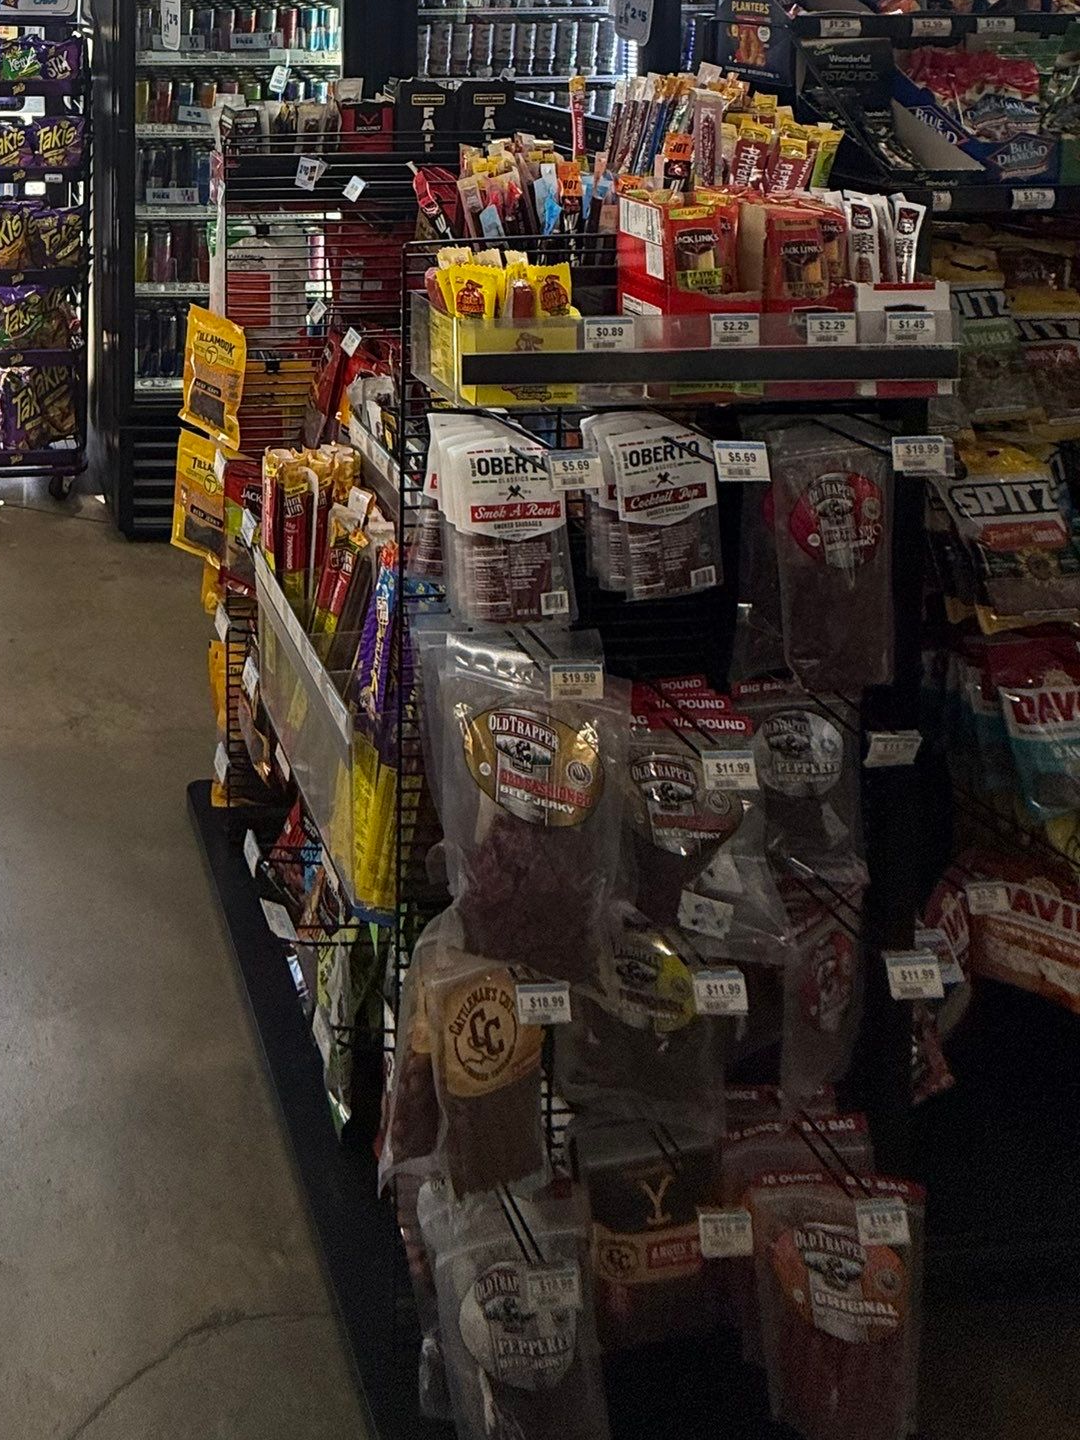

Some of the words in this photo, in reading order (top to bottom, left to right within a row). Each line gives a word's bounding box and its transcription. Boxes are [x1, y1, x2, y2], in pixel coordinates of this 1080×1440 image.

[731, 0, 770, 15] PLANTERS
[828, 54, 871, 63] Wonderful
[821, 71, 879, 82] PISTACHIOS
[37, 123, 76, 155] Takis
[1010, 140, 1036, 152] BLUE
[997, 145, 1049, 166] DIAMOND
[563, 180, 579, 190] HOT
[596, 327, 624, 336] $0.89
[723, 321, 749, 330] $2.29
[818, 321, 846, 330] $2.29
[899, 320, 925, 330] $1.49
[196, 329, 236, 358] TILLAMOOK
[13, 386, 40, 429] Tak
[629, 441, 699, 467] OBERTO
[729, 451, 757, 463] $5.69
[191, 456, 215, 473] TILLA
[477, 454, 545, 476] OBERT
[562, 460, 590, 472] $5.69
[631, 490, 674, 509] Cocktail
[949, 481, 1058, 517] SPITZ
[562, 672, 596, 684] $19.99
[661, 678, 702, 690] POUND
[677, 698, 725, 709] POUND
[1014, 690, 1080, 725] DAV
[697, 718, 746, 731] POUND
[716, 761, 750, 774] $11.99
[500, 785, 530, 801] BEEF
[533, 798, 575, 814] JERKY
[707, 983, 740, 996] $11.99
